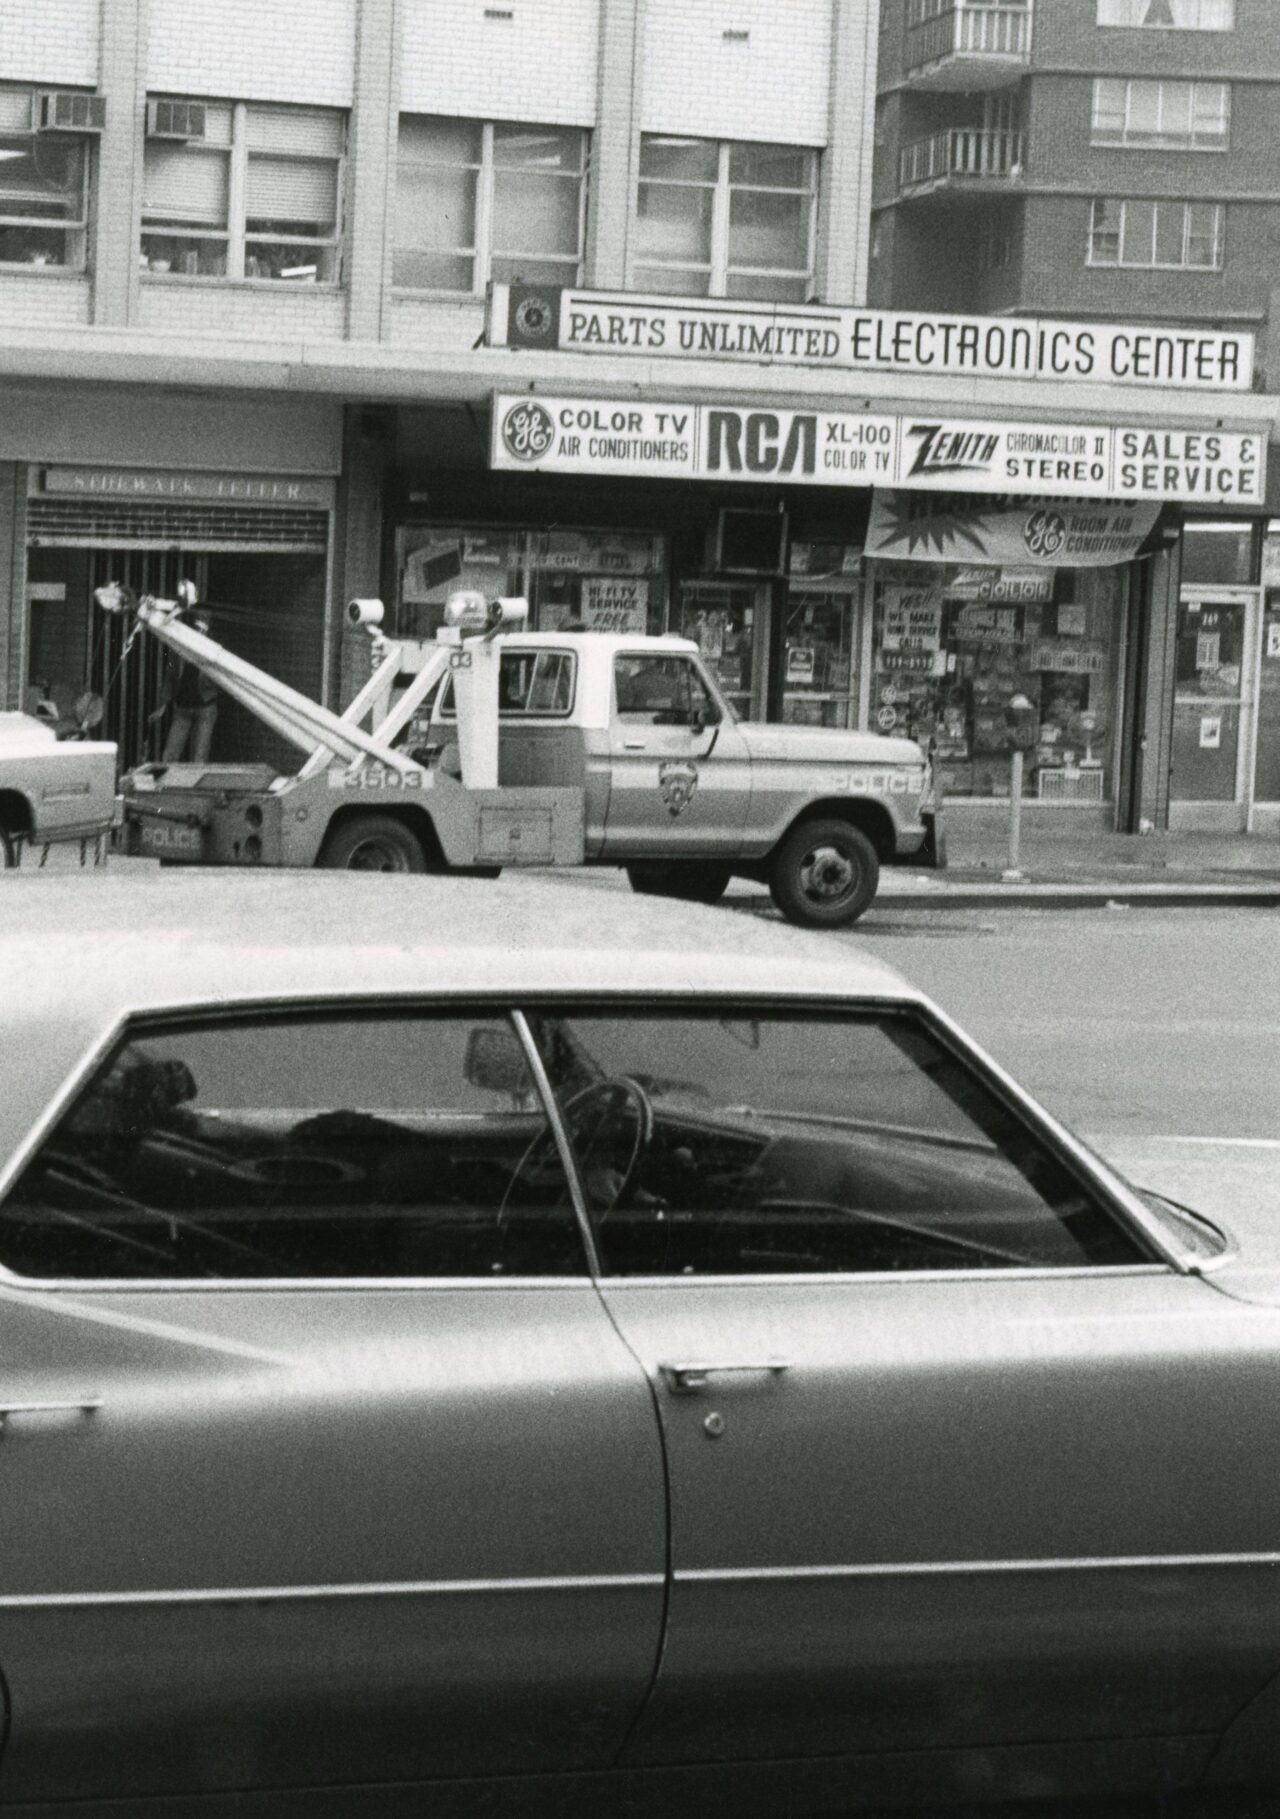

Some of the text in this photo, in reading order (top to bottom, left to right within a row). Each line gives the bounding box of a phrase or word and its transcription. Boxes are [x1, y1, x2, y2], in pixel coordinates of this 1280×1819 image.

[568, 313, 665, 347] PARTS
[678, 320, 840, 358] UNLIMITED
[851, 318, 1095, 375] ELECTRONICS
[1110, 333, 1240, 381] CENTER
[559, 409, 688, 434] COLOR TV
[826, 421, 891, 444] XL-100
[558, 438, 689, 463] AIR CONDITIONERS
[706, 410, 818, 475] RCA
[905, 424, 1001, 479] ZENITH
[1006, 432, 1104, 456] CHROMACOLOR II
[1122, 433, 1255, 464] SALES &
[824, 449, 889, 471] COLOR TV
[1006, 458, 1105, 481] STEREO
[1121, 464, 1255, 495] SERVICE
[1070, 516, 1134, 534] ROOM AIR
[620, 586, 637, 599] TV
[980, 580, 1049, 599] COLOR
[588, 598, 639, 611] SERVICE
[344, 770, 422, 790] 3503
[142, 826, 201, 850] POLICE
